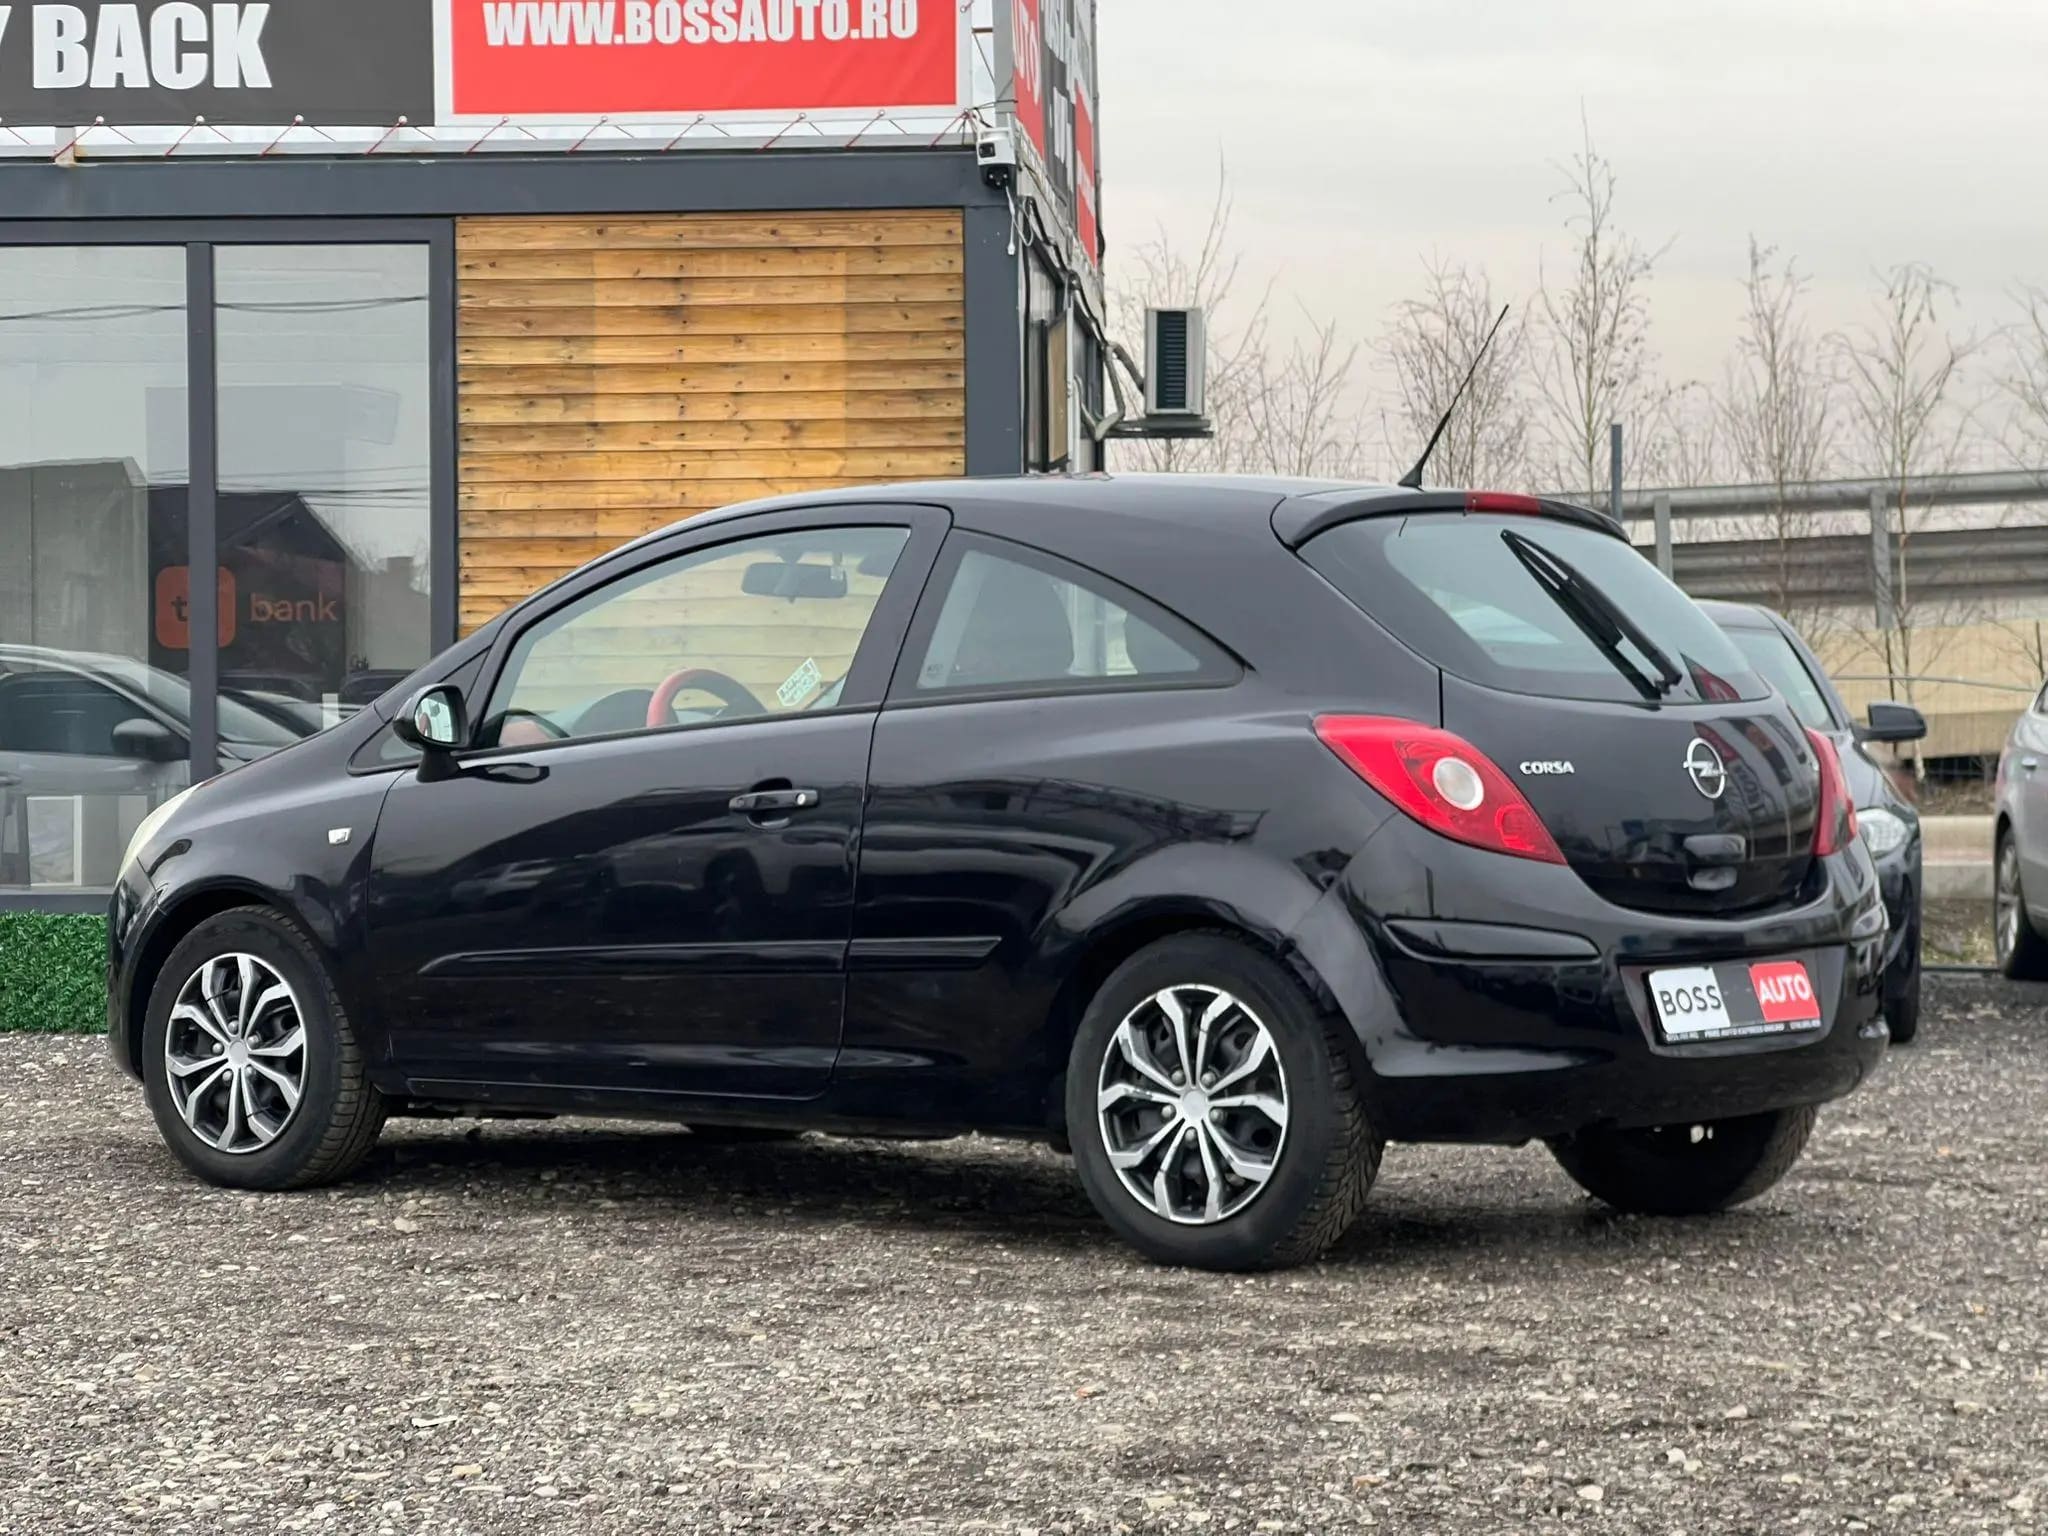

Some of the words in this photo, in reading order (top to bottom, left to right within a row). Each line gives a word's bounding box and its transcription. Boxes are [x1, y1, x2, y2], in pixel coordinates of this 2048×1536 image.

[483, 0, 920, 46] WWW.BOSSAUTO.RO
[32, 2, 273, 90] BACK
[250, 592, 338, 622] bank
[1519, 760, 1575, 775] CORSA
[1657, 984, 1722, 1016] BOSS
[1758, 974, 1811, 1005] AUTO
